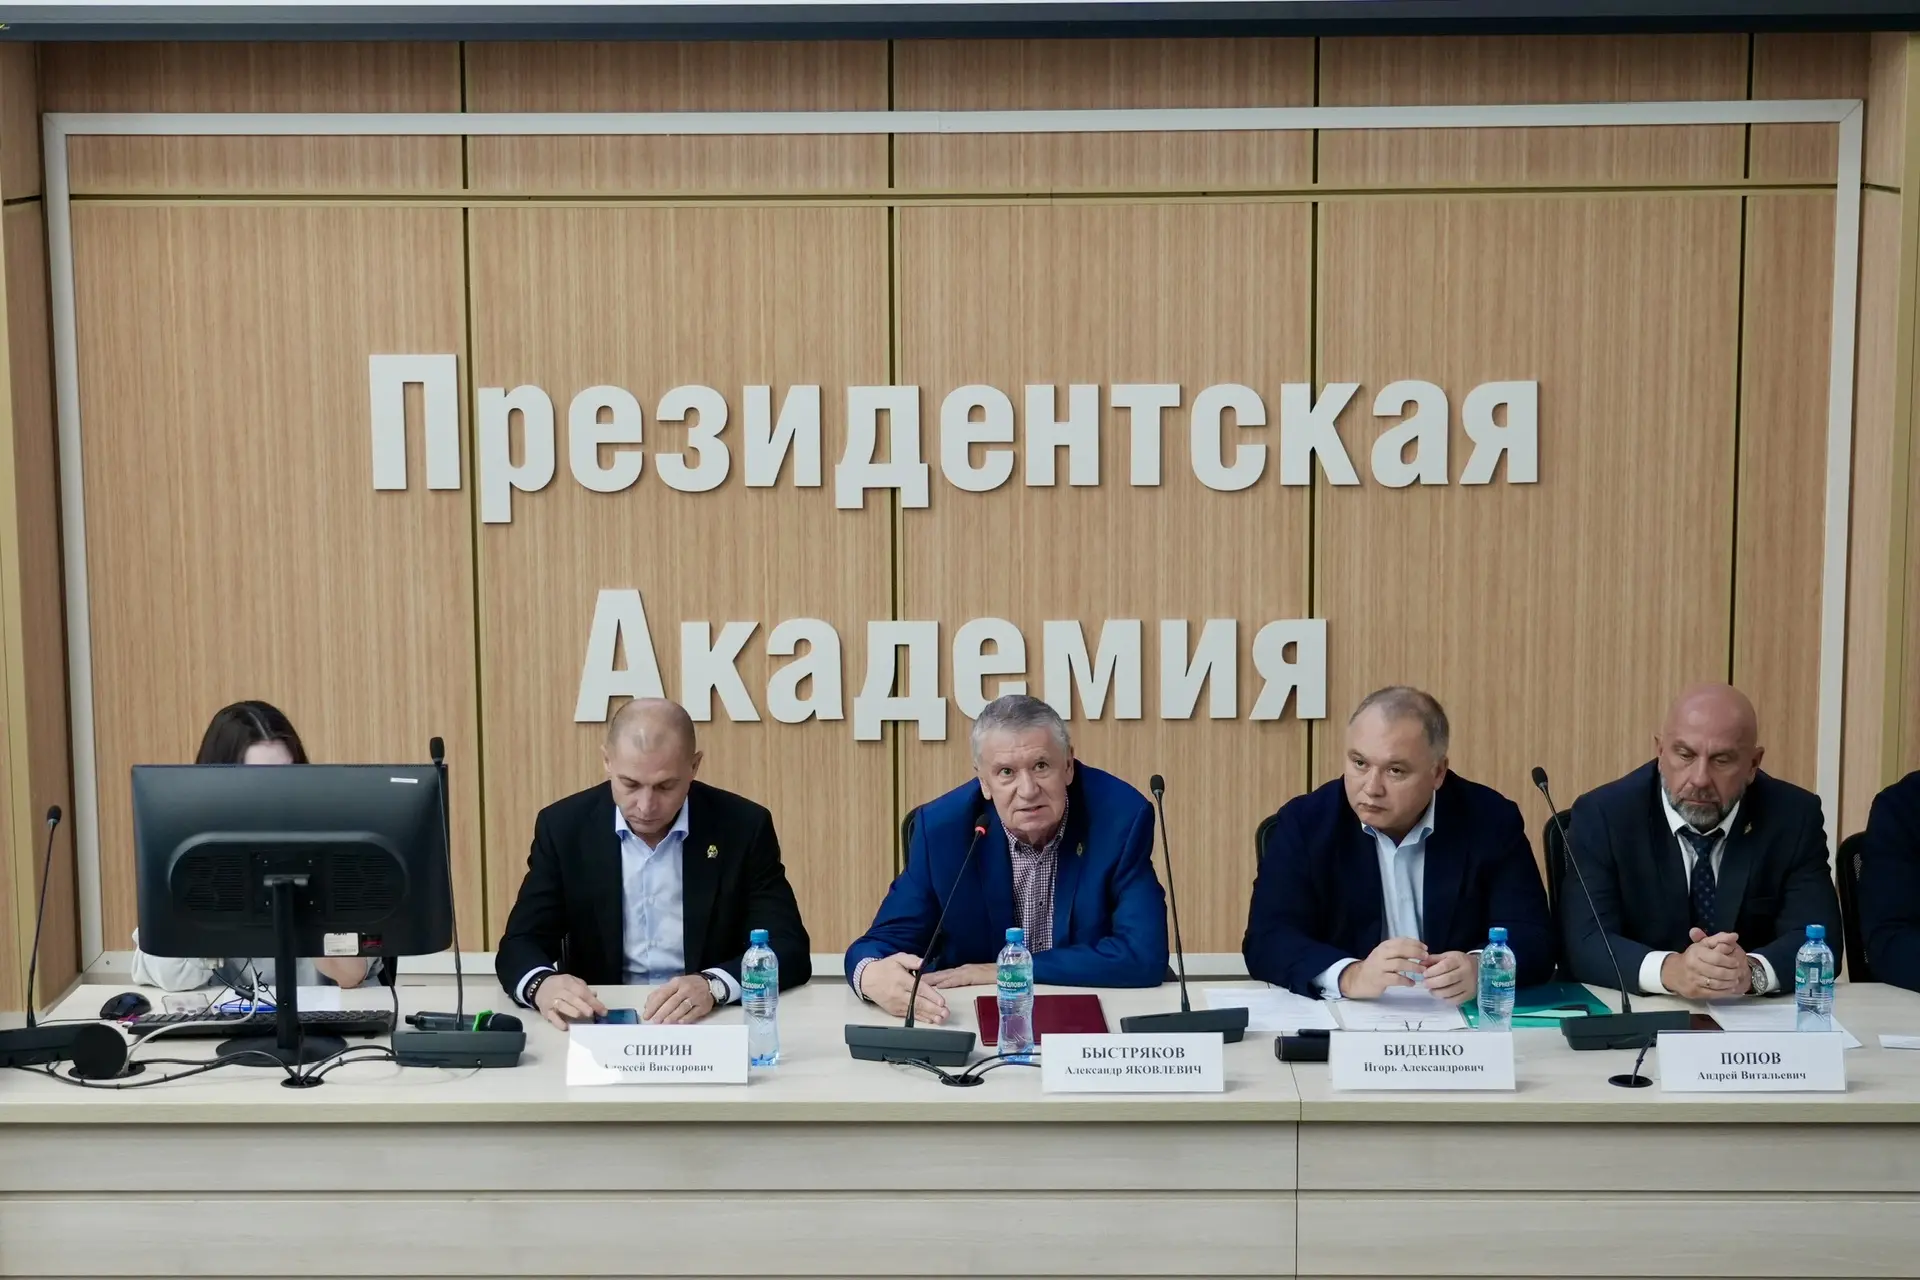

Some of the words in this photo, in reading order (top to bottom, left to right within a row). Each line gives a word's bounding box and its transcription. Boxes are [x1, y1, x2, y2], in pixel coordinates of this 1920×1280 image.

[369, 353, 1539, 524] Президентская
[574, 588, 1328, 741] Академия
[623, 1044, 692, 1056] СПИРИН
[1082, 1046, 1186, 1059] БЫСТРЯКОВ
[1383, 1044, 1465, 1058] БИДЕНКО
[1720, 1051, 1782, 1066] ПОПОВ
[649, 1061, 714, 1074] Викторович
[1065, 1065, 1122, 1077] Александр
[1126, 1065, 1202, 1075] ЯКОВЛЕВИЧ
[1364, 1061, 1397, 1075] Игорь
[1400, 1063, 1484, 1075] Александрович
[1697, 1070, 1738, 1083] Андрей
[1741, 1070, 1807, 1081] Витальевич
